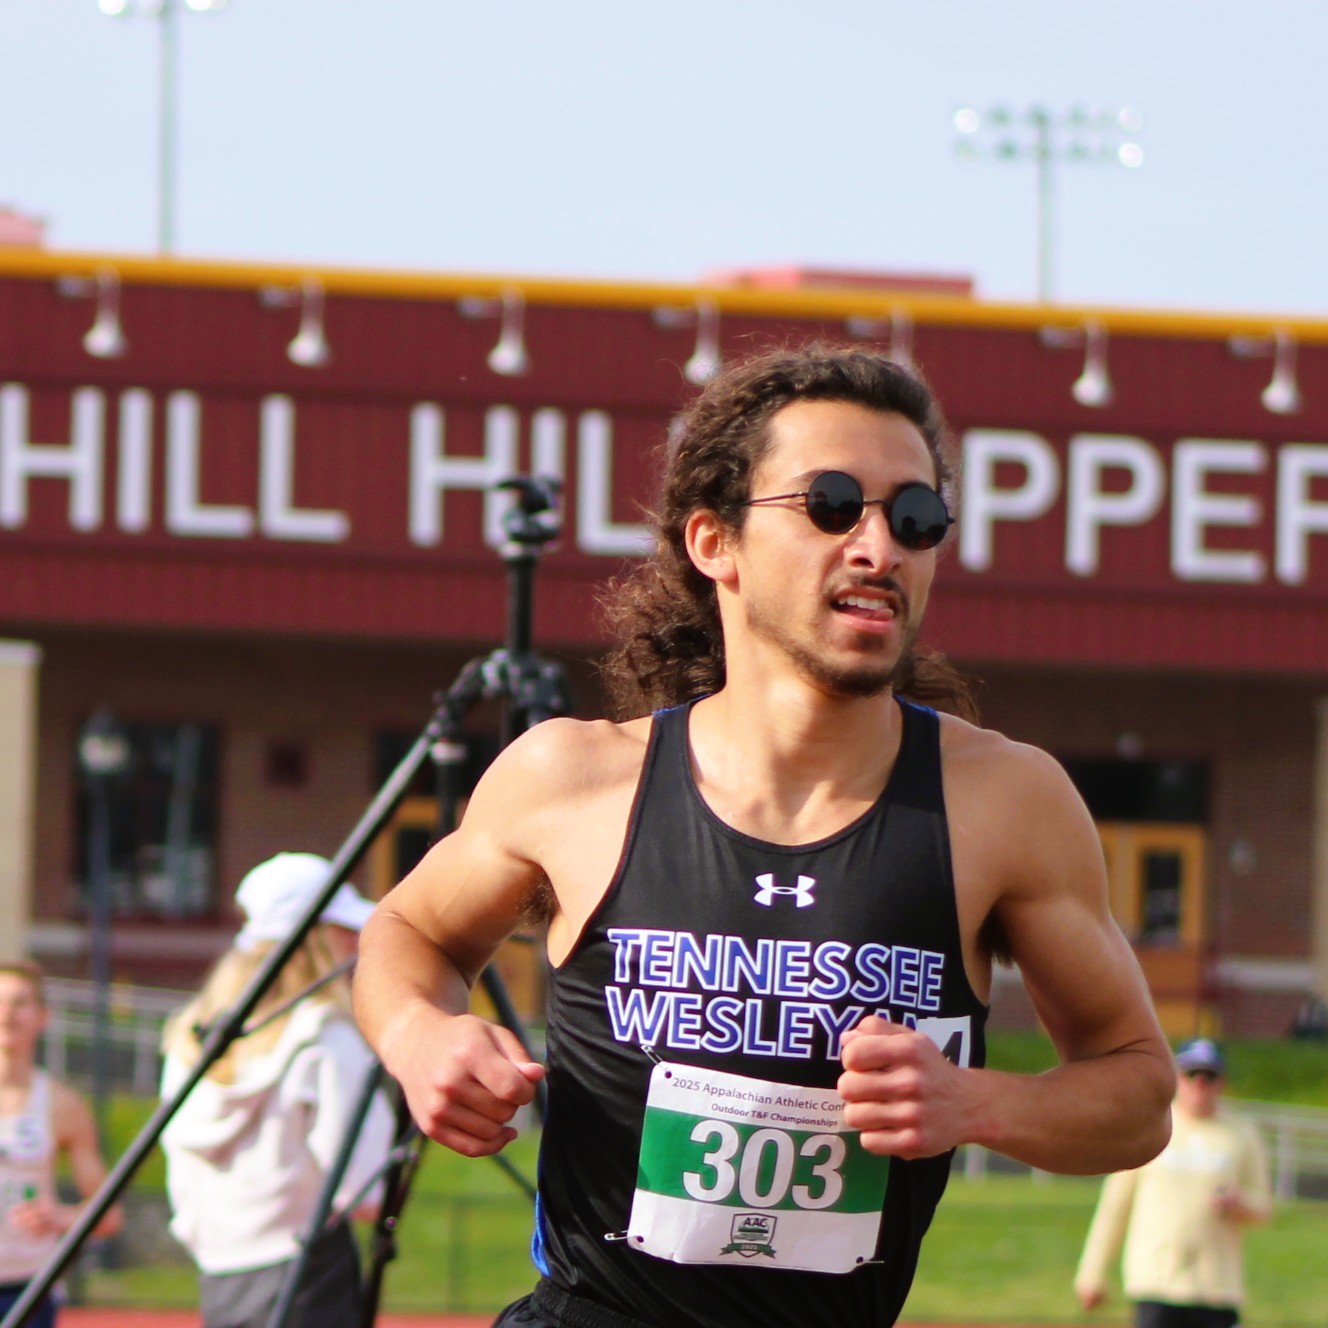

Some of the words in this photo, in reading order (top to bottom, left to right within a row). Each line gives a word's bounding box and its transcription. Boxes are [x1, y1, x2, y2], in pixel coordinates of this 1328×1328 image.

[606, 928, 945, 1011] TENNESSEE
[604, 985, 930, 1061] WESLEY
[672, 1077, 701, 1092] 2025
[702, 1083, 773, 1105] Appalachian
[774, 1096, 818, 1111] Athletic
[711, 1103, 750, 1118] Outdoor
[750, 1110, 769, 1120] T&F
[770, 1112, 838, 1129] Championships
[682, 1119, 847, 1211] 303
[742, 1216, 768, 1228] AAC
